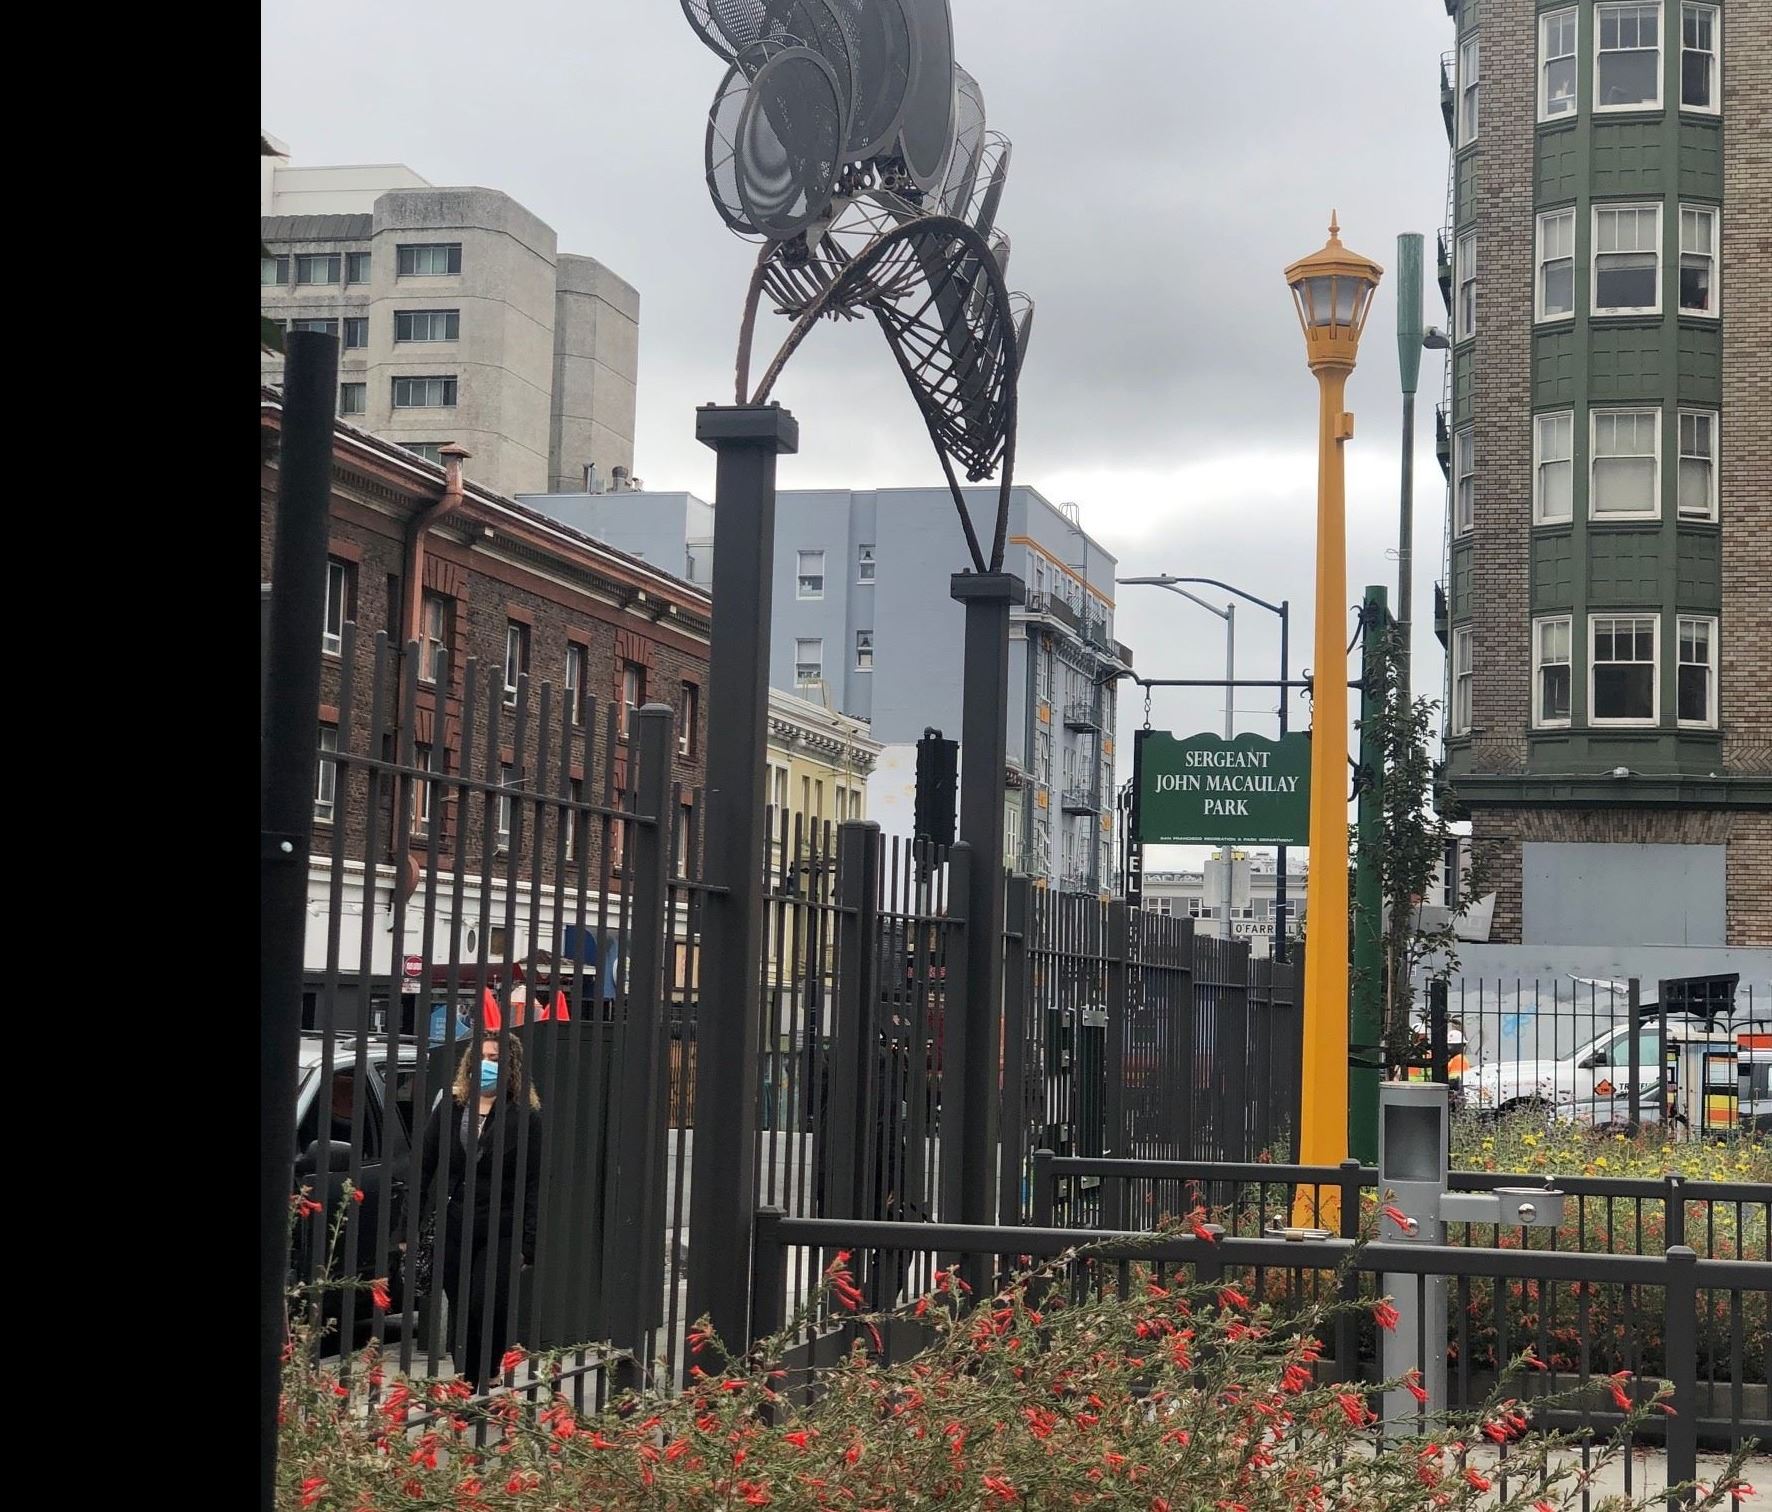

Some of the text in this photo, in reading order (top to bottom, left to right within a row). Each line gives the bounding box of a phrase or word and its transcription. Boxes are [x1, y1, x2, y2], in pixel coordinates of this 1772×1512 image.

[1185, 751, 1271, 768] SERGEANT
[1155, 774, 1300, 793] JOHN MACAULAY
[1203, 799, 1249, 816] PARK
